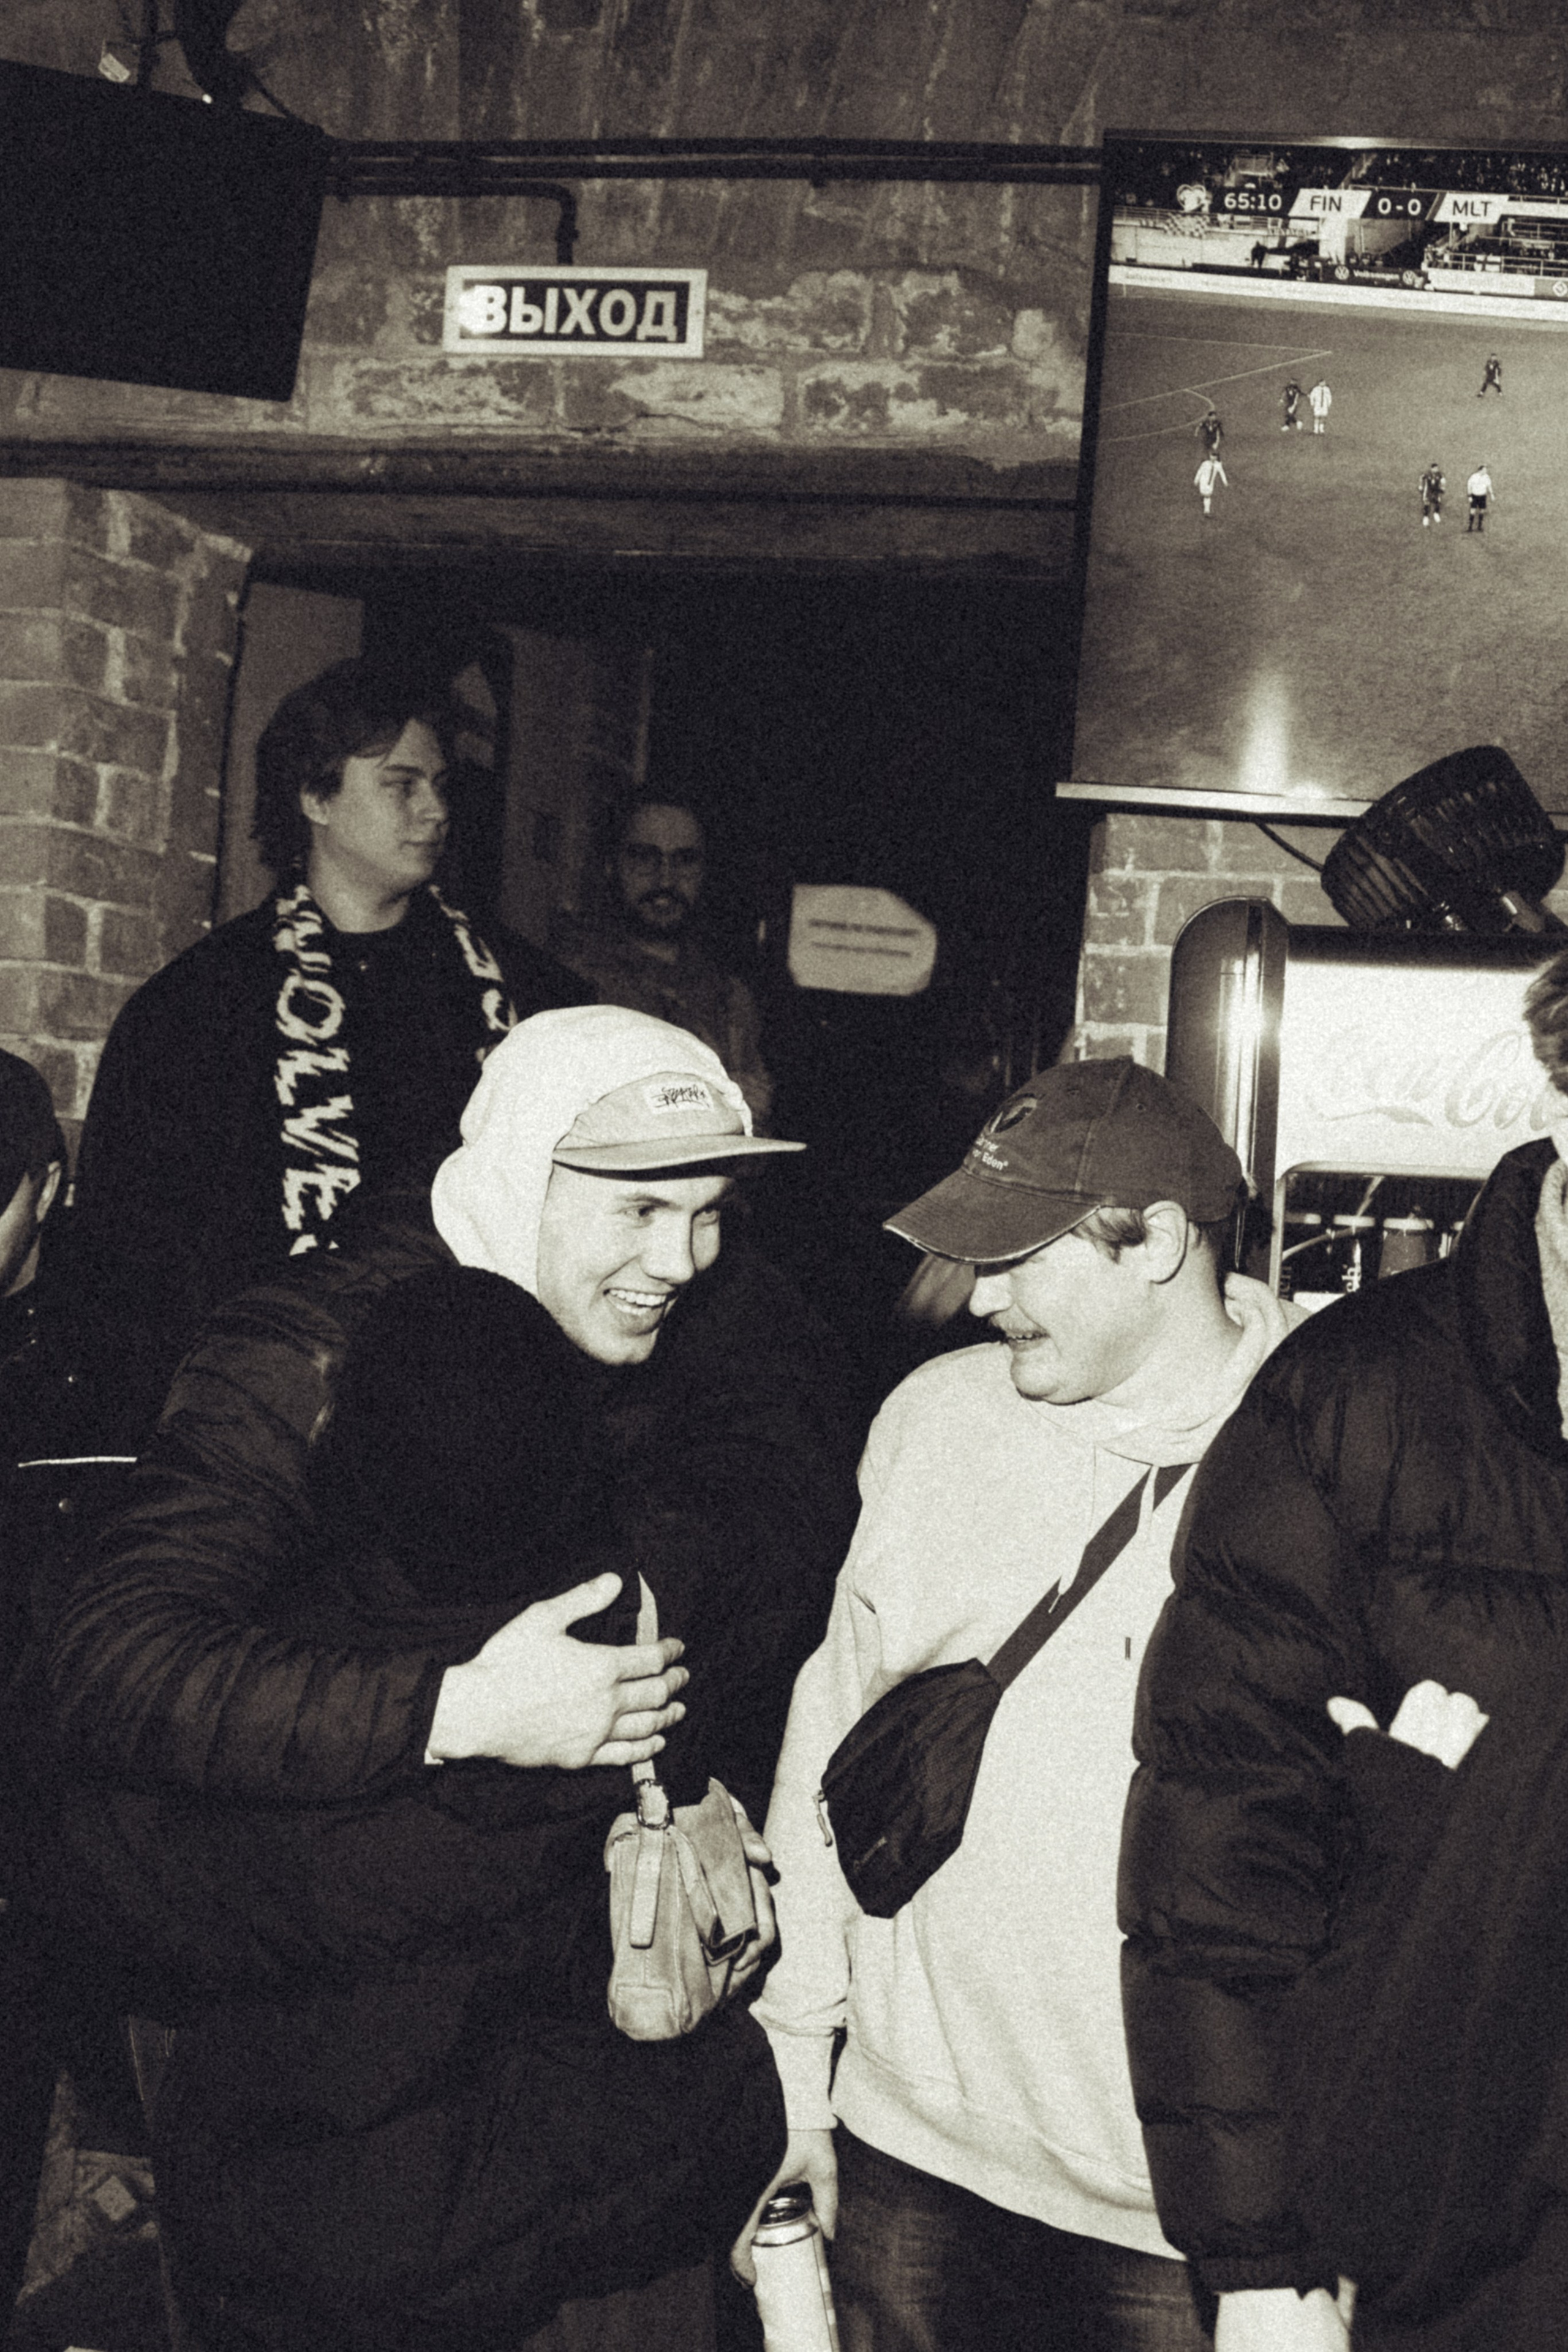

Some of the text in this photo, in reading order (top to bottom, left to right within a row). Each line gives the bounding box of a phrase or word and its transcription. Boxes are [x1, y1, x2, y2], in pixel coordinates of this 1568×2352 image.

[1224, 192, 1283, 211] 65:10
[1310, 195, 1342, 212] FIN
[1452, 200, 1493, 217] MLT
[464, 285, 678, 342] ВЫХОД
[274, 884, 361, 1256] WOLVE
